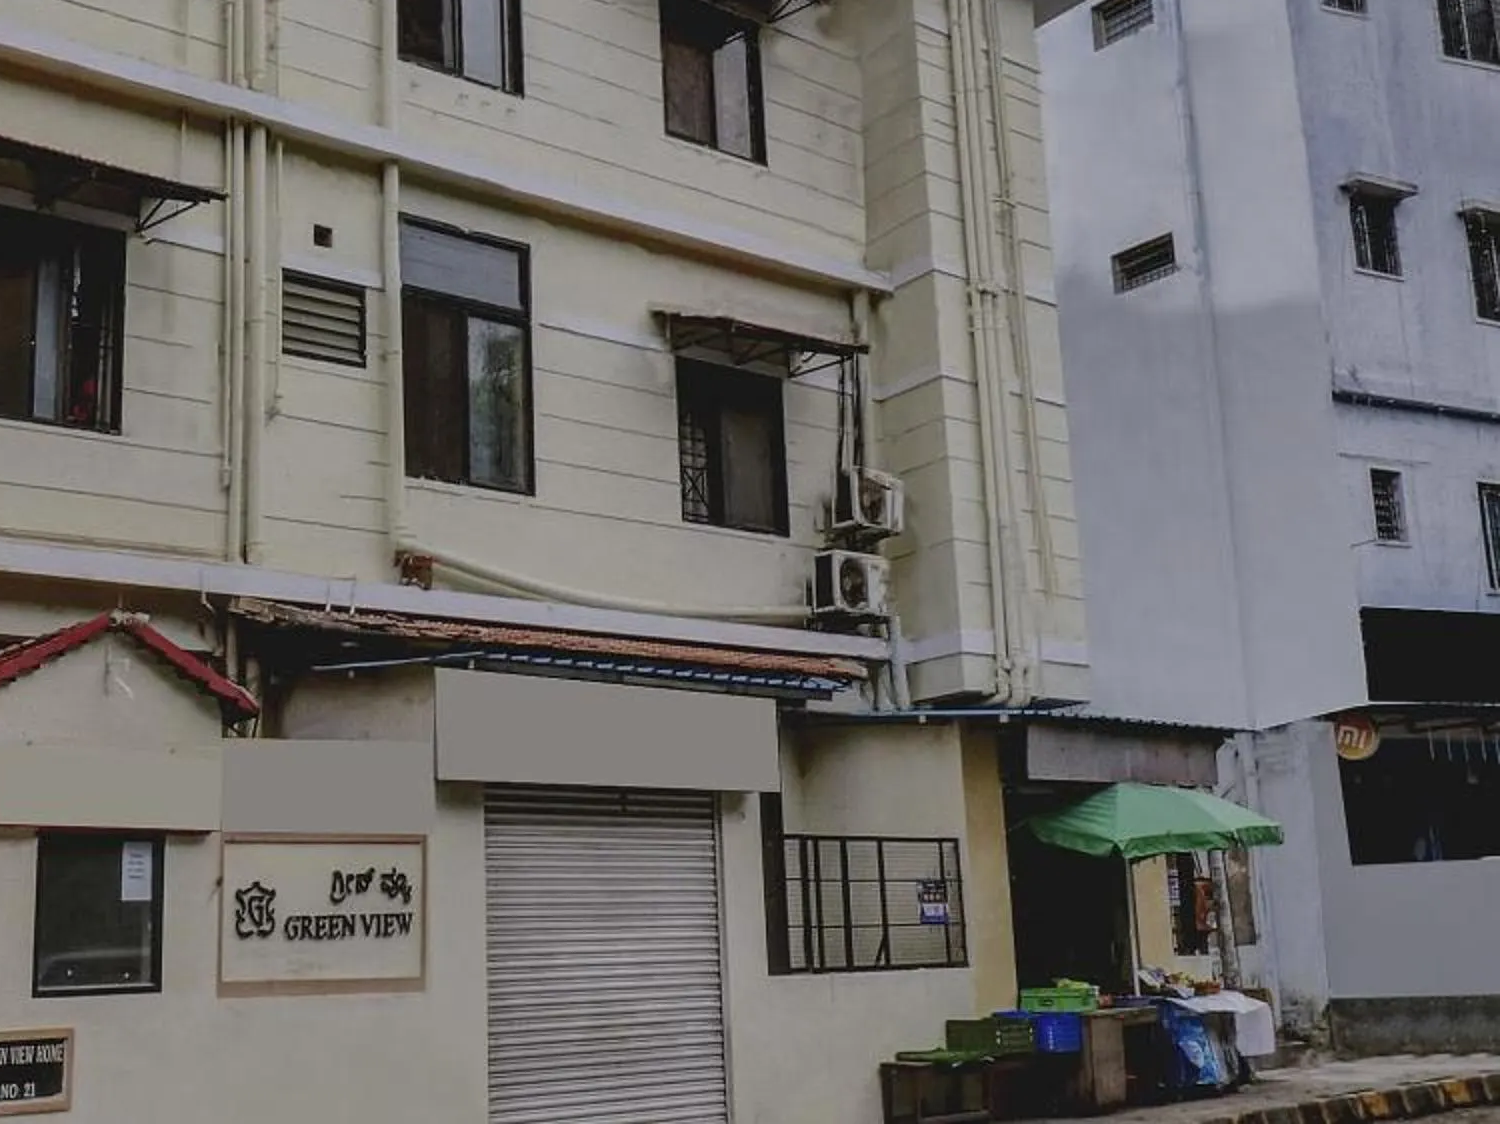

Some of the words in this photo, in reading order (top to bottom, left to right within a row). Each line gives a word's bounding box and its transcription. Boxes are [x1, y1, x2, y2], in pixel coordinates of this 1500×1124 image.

[284, 914, 357, 941] GREEN
[360, 912, 413, 937] VIEW
[10, 1045, 35, 1065] VIEW
